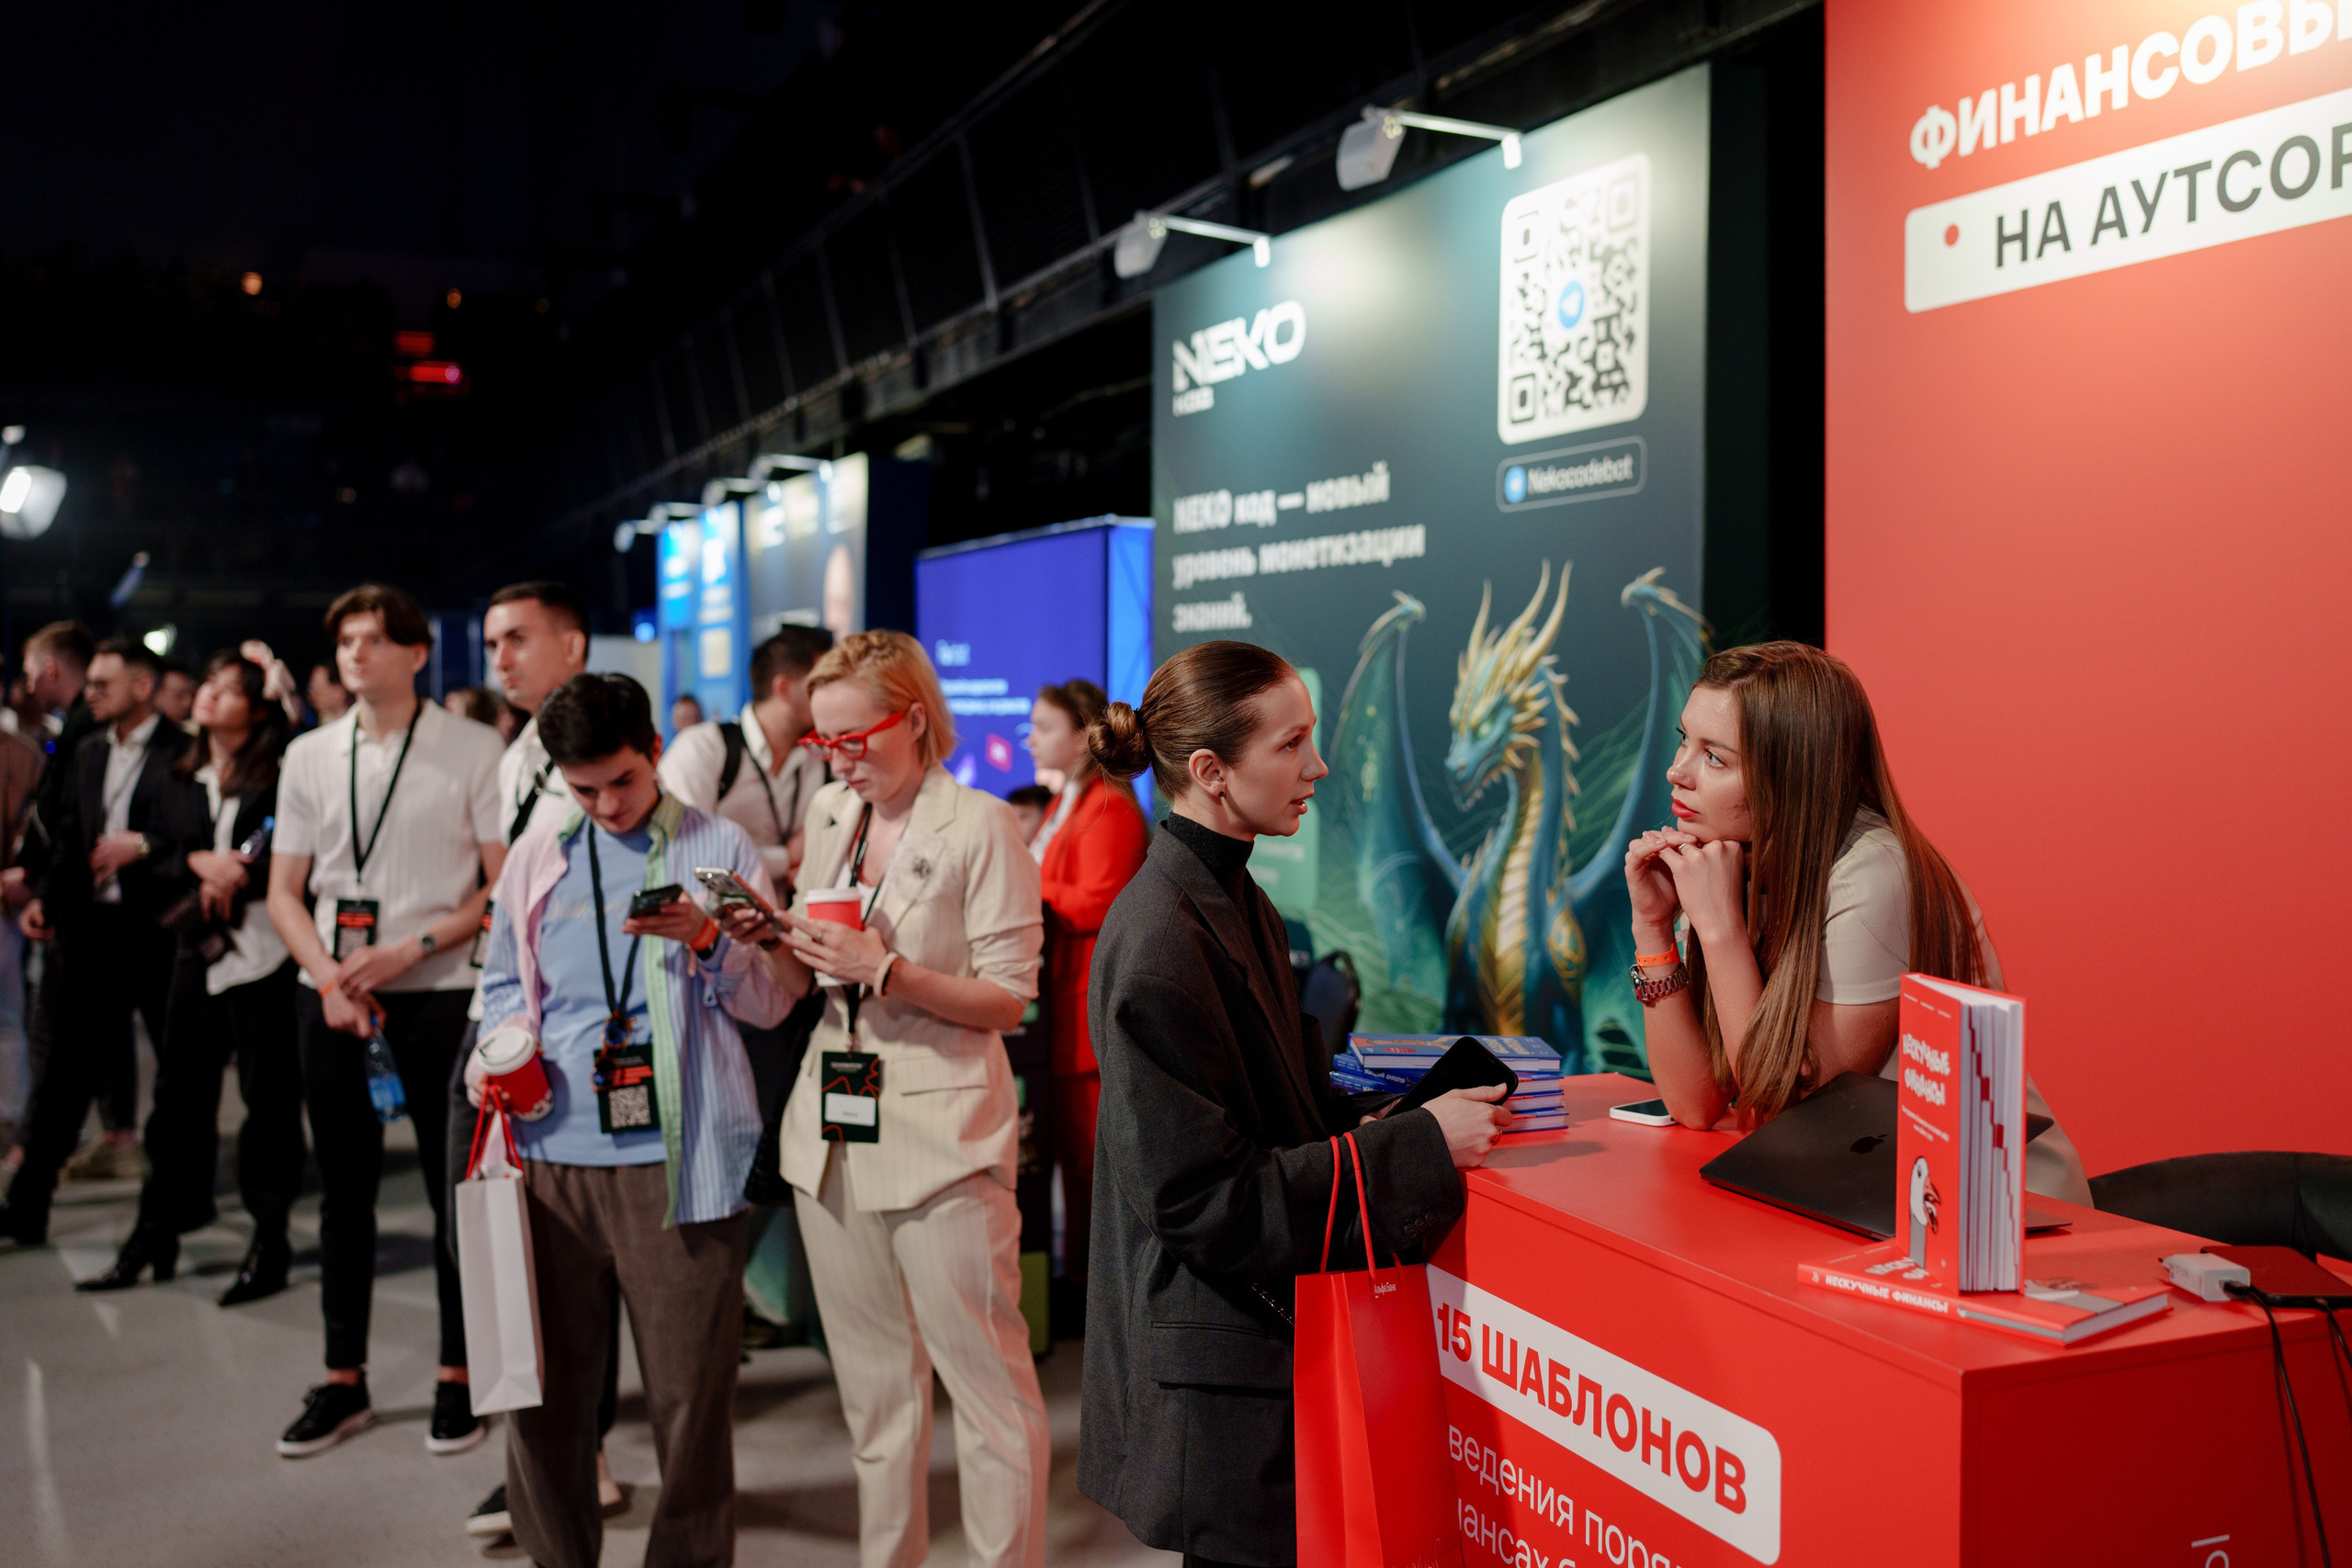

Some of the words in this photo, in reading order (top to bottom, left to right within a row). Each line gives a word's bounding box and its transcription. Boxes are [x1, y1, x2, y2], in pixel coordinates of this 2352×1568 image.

[1996, 200, 2073, 268] НА
[1172, 299, 1306, 395] NEKO
[1825, 1274, 1890, 1300] НЕСКУЧНЫЕ
[1892, 1290, 1949, 1314] ФИНАНСЫ
[1437, 1303, 1472, 1362] 15
[1482, 1324, 1747, 1516] ШАБЛОНОВ
[1449, 1424, 1574, 1535] ведения
